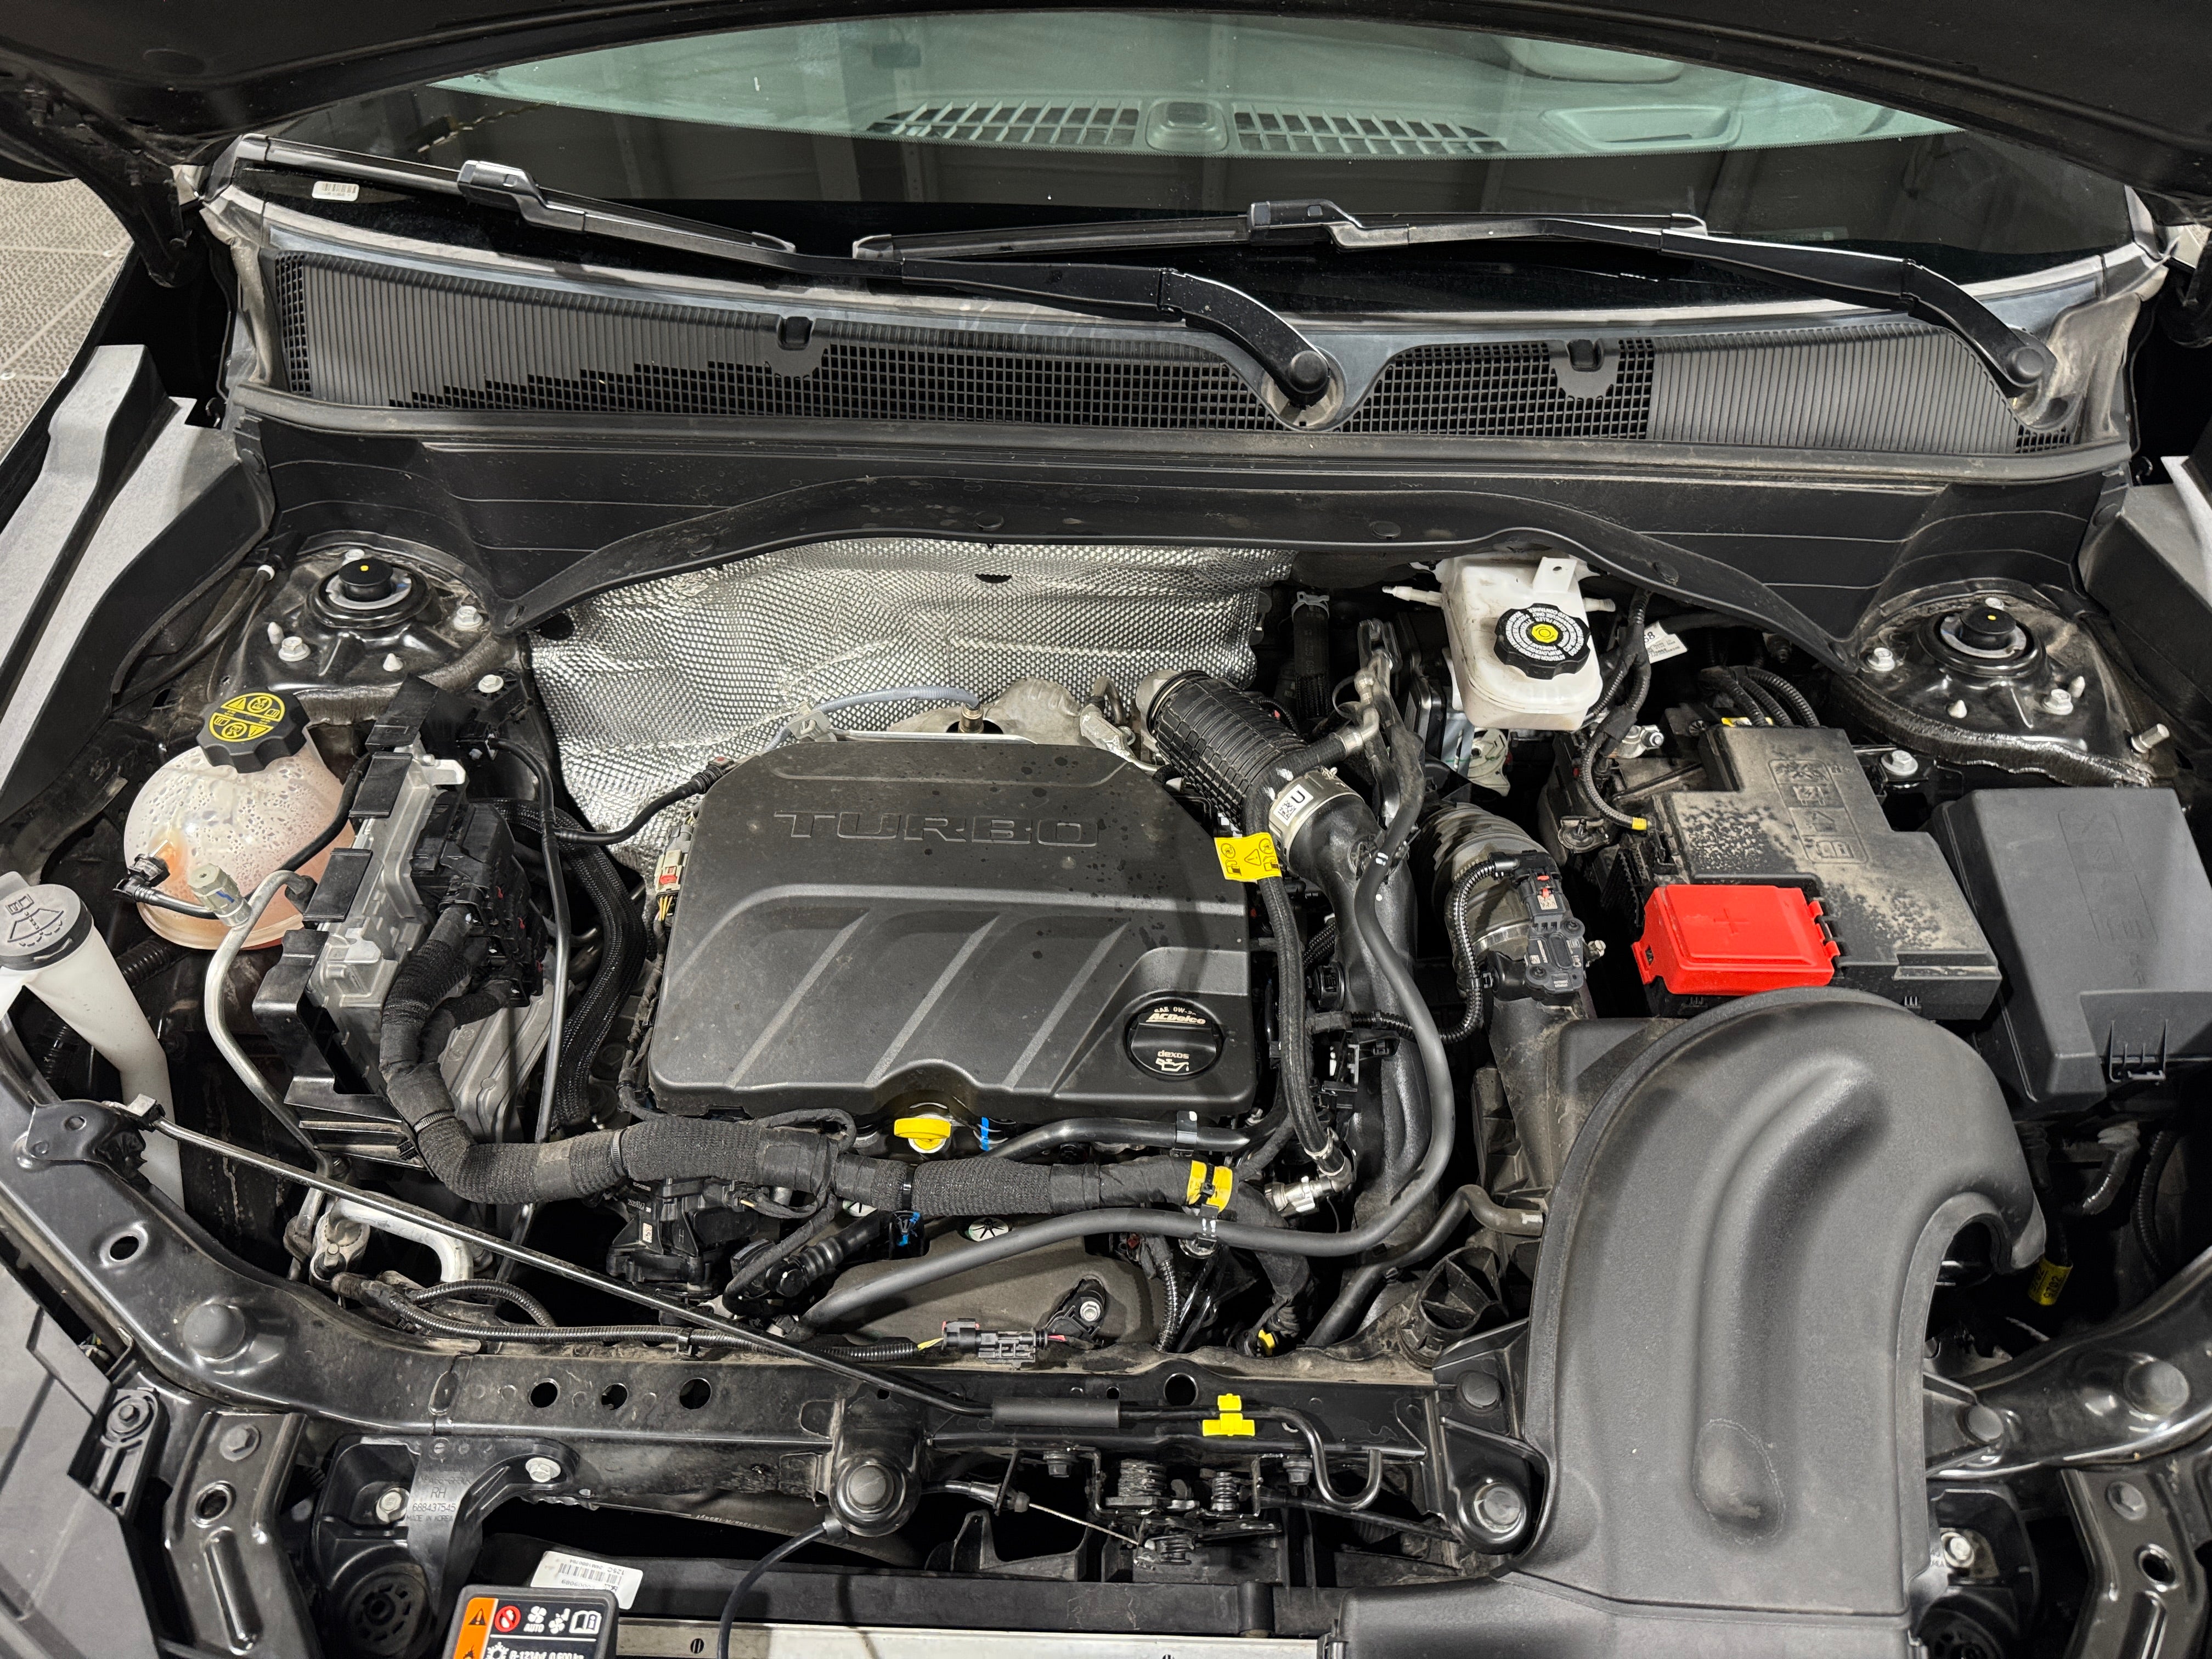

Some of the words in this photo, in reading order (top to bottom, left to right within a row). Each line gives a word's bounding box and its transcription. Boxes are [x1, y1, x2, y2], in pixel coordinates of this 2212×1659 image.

[1290, 790, 1305, 803] U
[774, 812, 1097, 847] TURBO
[1148, 1013, 1206, 1024] ACDelco
[1158, 1050, 1190, 1059] dexos
[430, 1486, 447, 1498] RH
[412, 1503, 456, 1513] 688437545
[523, 1623, 545, 1633] AUTO
